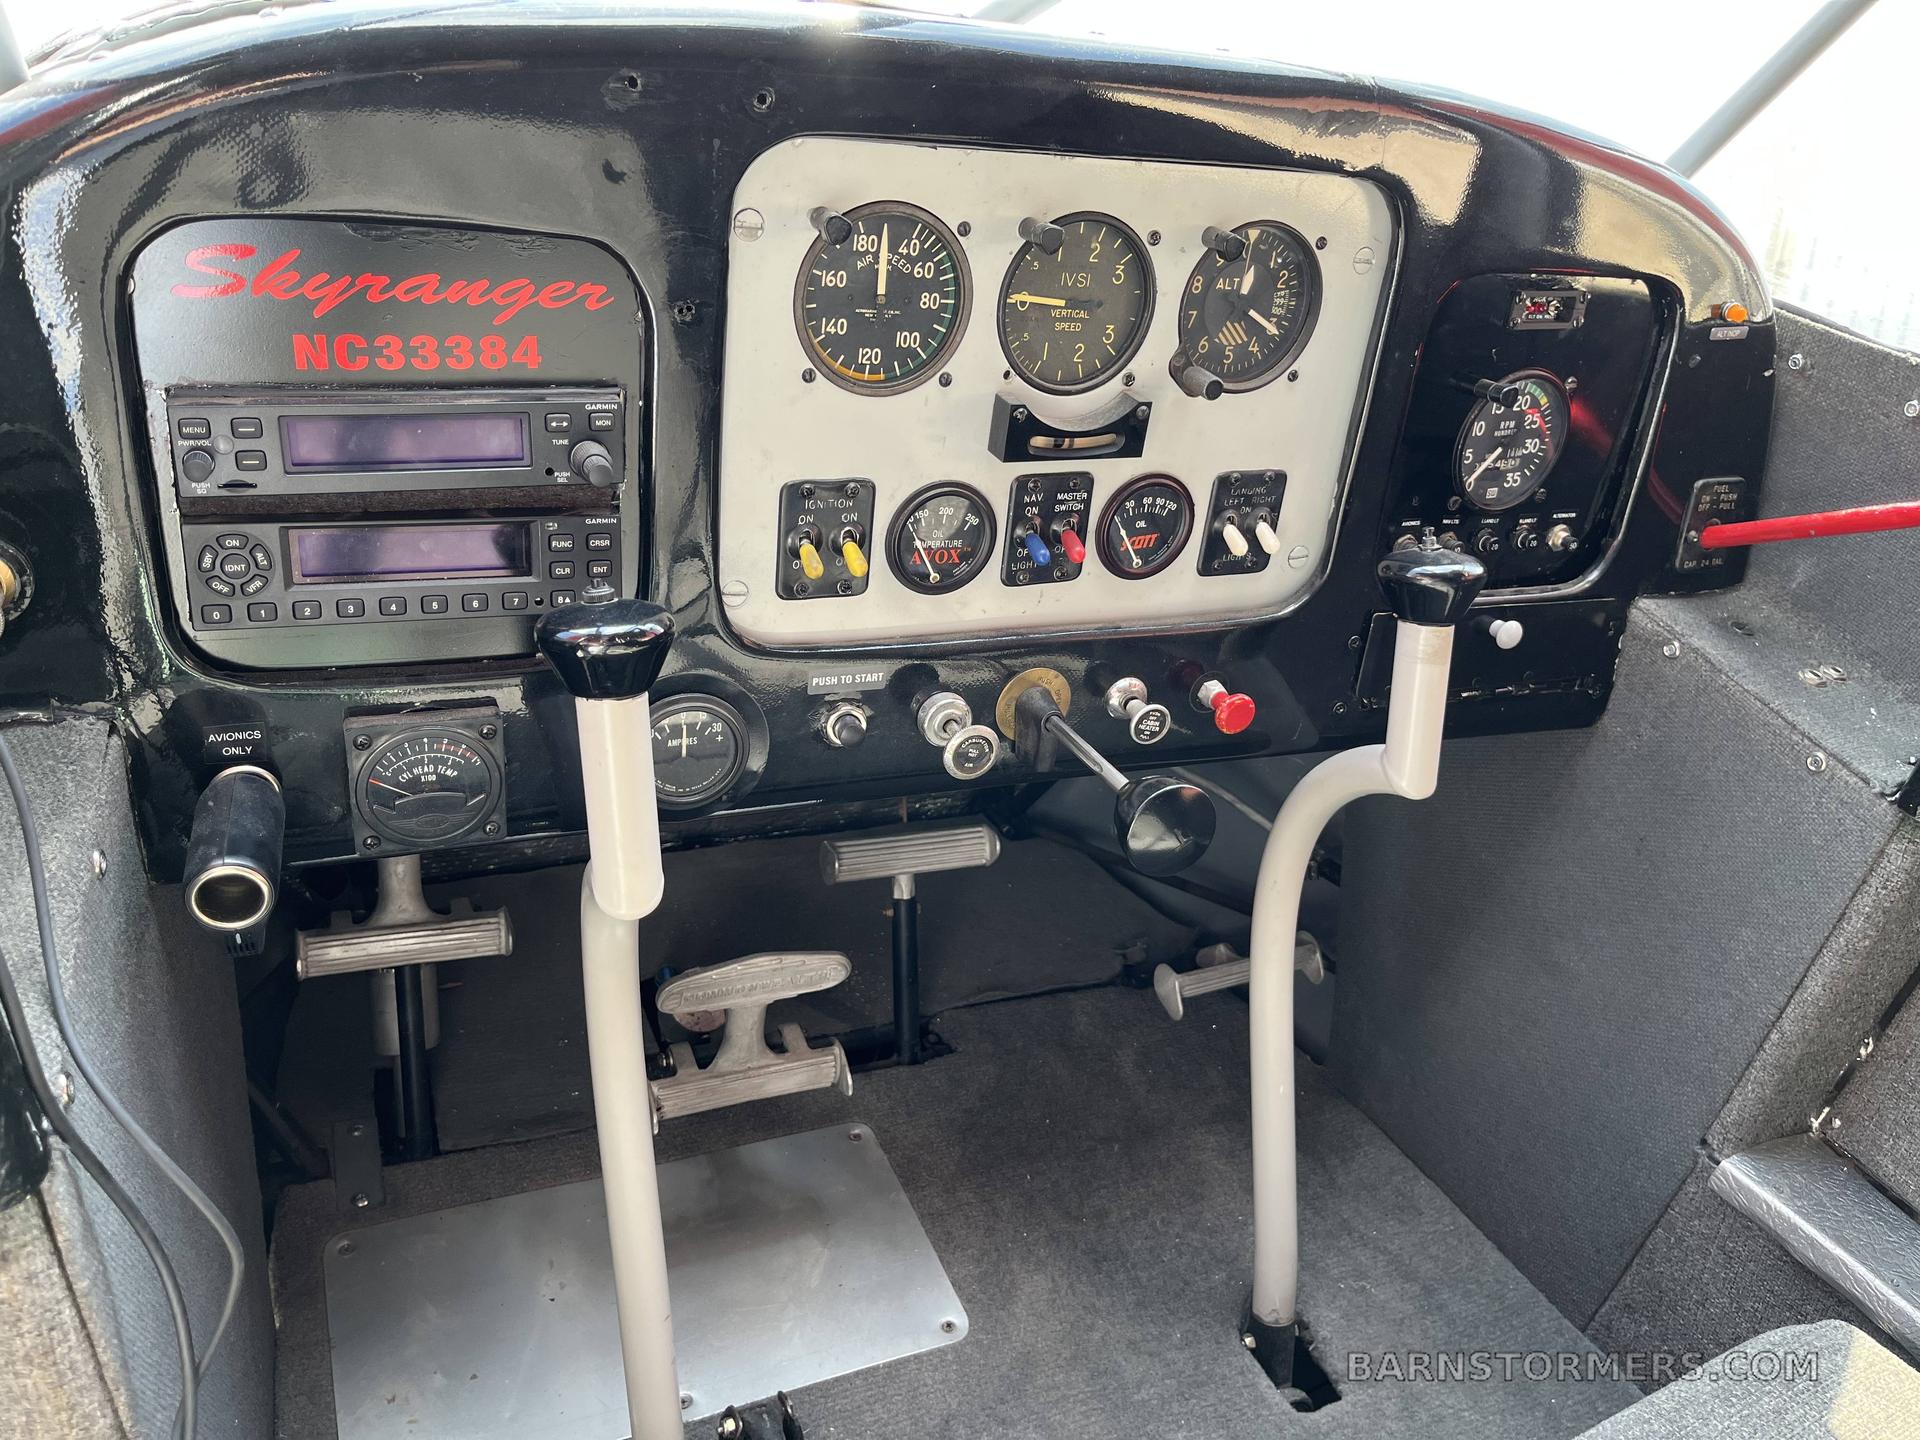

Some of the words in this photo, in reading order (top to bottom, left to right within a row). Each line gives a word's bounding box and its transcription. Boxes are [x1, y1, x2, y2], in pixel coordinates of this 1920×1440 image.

[853, 234, 878, 252] 180
[898, 239, 920, 256] 40
[1089, 243, 1100, 262] 2
[856, 254, 874, 270] AIR
[879, 253, 912, 274] PEED
[914, 262, 934, 278] 60
[1030, 261, 1039, 270] .5
[821, 270, 847, 288] 160
[1061, 272, 1091, 288] IVSI
[1112, 265, 1124, 284] 3
[1277, 270, 1288, 288] 2
[171, 243, 614, 326] Skyranger
[1192, 275, 1203, 293] 8
[1216, 278, 1240, 290] ALT
[920, 292, 940, 310] 80
[1050, 309, 1090, 318] VERTICAL
[1187, 311, 1197, 328] 7
[821, 317, 847, 335] 140
[1055, 322, 1081, 331] SPEED
[896, 331, 920, 348] 100
[1103, 325, 1114, 344] 3
[1198, 336, 1208, 353] 6
[1248, 336, 1259, 353] 4
[293, 333, 542, 371] NC33384
[858, 348, 881, 364] 120
[1074, 343, 1085, 362] 2
[1223, 346, 1234, 363] 5
[1513, 394, 1531, 411] 20
[1500, 420, 1516, 429] RPM
[1524, 414, 1540, 429] 25
[1472, 421, 1485, 436] 10
[1523, 438, 1540, 454] 30
[1464, 449, 1473, 464] 5
[1503, 472, 1521, 487] 35
[1230, 486, 1267, 496] LANDING
[1713, 484, 1729, 493] FUEL
[1057, 492, 1088, 500] MASTER
[1155, 497, 1165, 505] 90
[1224, 497, 1244, 506] LEFT
[1252, 495, 1276, 503] RIGHT
[805, 499, 854, 510] IGNITION
[939, 507, 953, 515] 200
[1054, 503, 1084, 512] SWITCH
[1125, 500, 1135, 509] 30
[1165, 500, 1177, 510] 120
[1241, 506, 1252, 514] ON
[841, 512, 858, 522] ON
[915, 509, 929, 519] 150
[1025, 506, 1039, 517] ON
[798, 514, 814, 525] ON
[965, 513, 979, 526] 250
[1135, 520, 1147, 528] OIL
[932, 530, 943, 538] OIL
[203, 552, 213, 568] SBY
[255, 552, 267, 566] ALT
[909, 548, 961, 565] AVOX
[212, 581, 229, 593] OFF
[246, 580, 263, 593] VFR
[260, 609, 265, 617] 1
[304, 607, 311, 615] 2
[347, 605, 354, 613] 3
[390, 603, 397, 611] 4
[213, 611, 220, 619] 0
[813, 676, 837, 686] PUSH
[841, 675, 852, 684] TO
[855, 673, 884, 683] START
[711, 722, 722, 732] 30
[1138, 724, 1160, 732] HEATER
[1142, 719, 1160, 727] CABIN
[208, 730, 262, 743] AVIONICS
[222, 746, 252, 755] ONLY
[399, 771, 414, 782] CYL
[413, 764, 434, 775] HEAD
[437, 764, 458, 778] TEMP
[421, 774, 437, 782] X100
